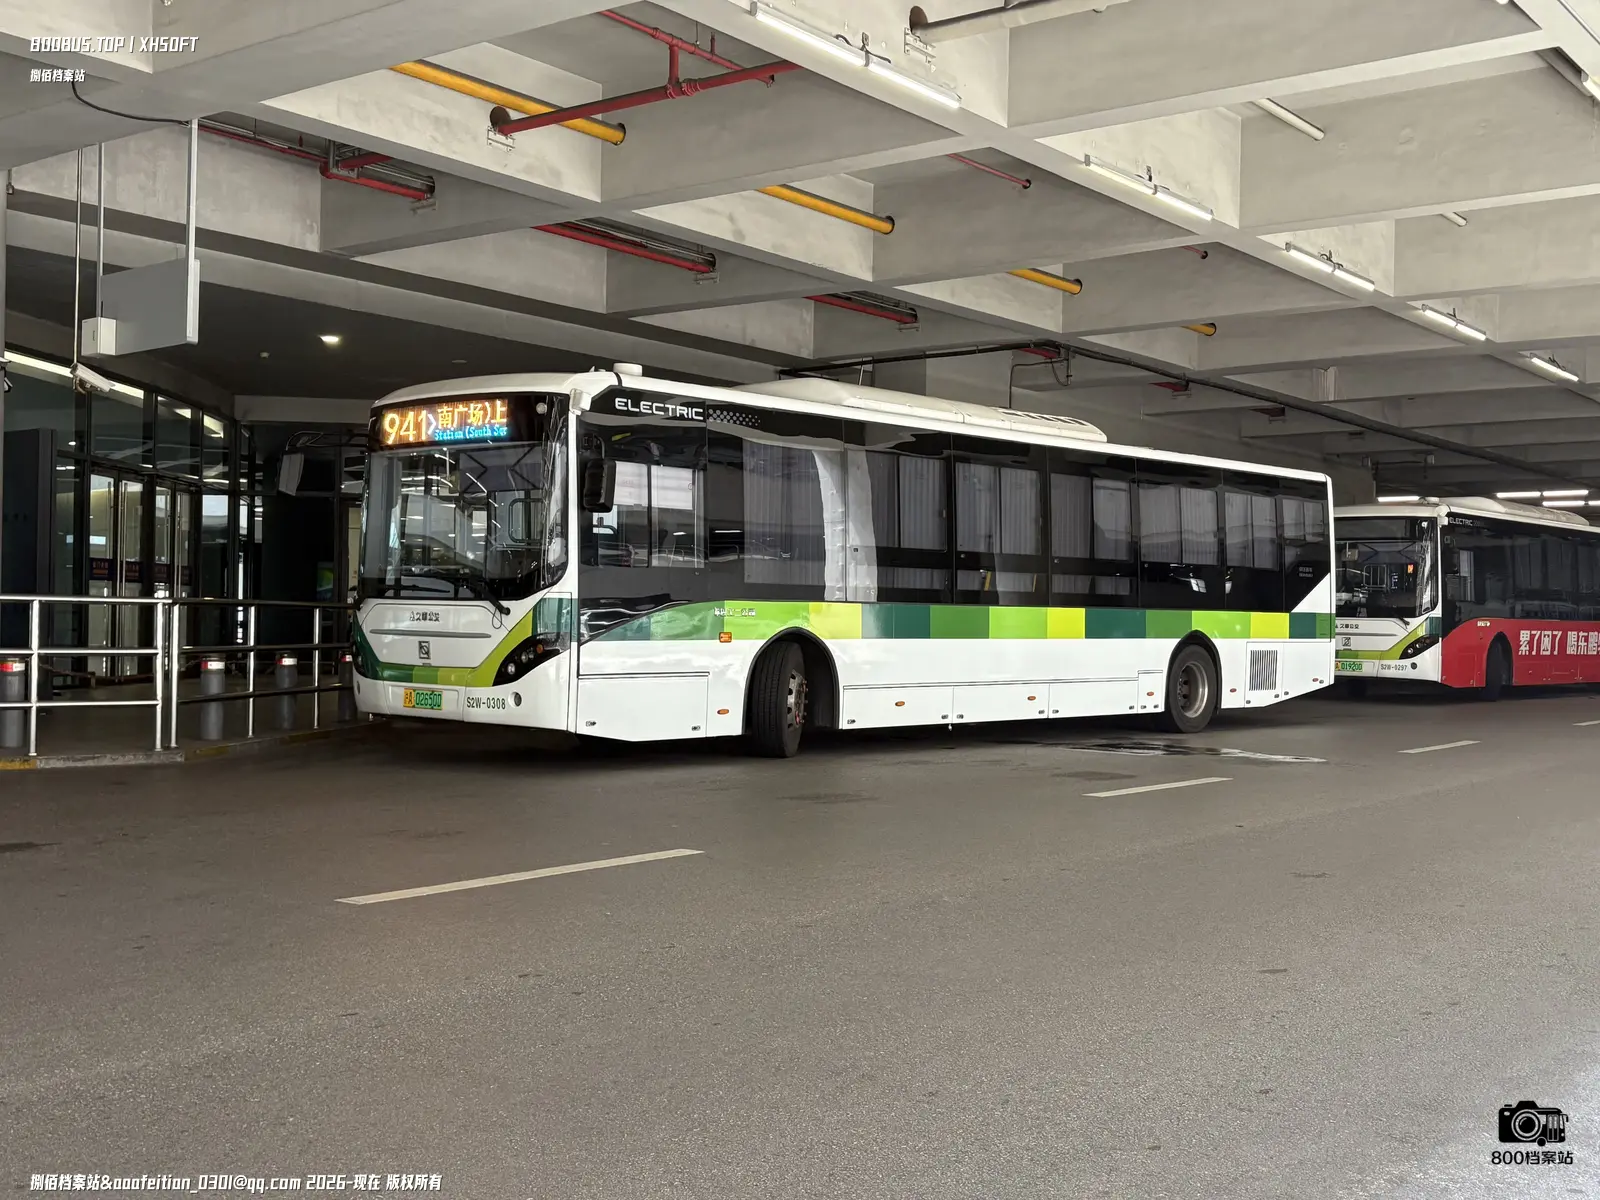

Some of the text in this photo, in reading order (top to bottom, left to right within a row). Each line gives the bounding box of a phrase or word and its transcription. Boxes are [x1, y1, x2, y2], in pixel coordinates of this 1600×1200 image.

[615, 397, 704, 420] ELECTRIC
[384, 409, 427, 444] 941
[1519, 630, 1600, 655] 累了困了 喝东鹏
[467, 697, 506, 710] S2W-0308
